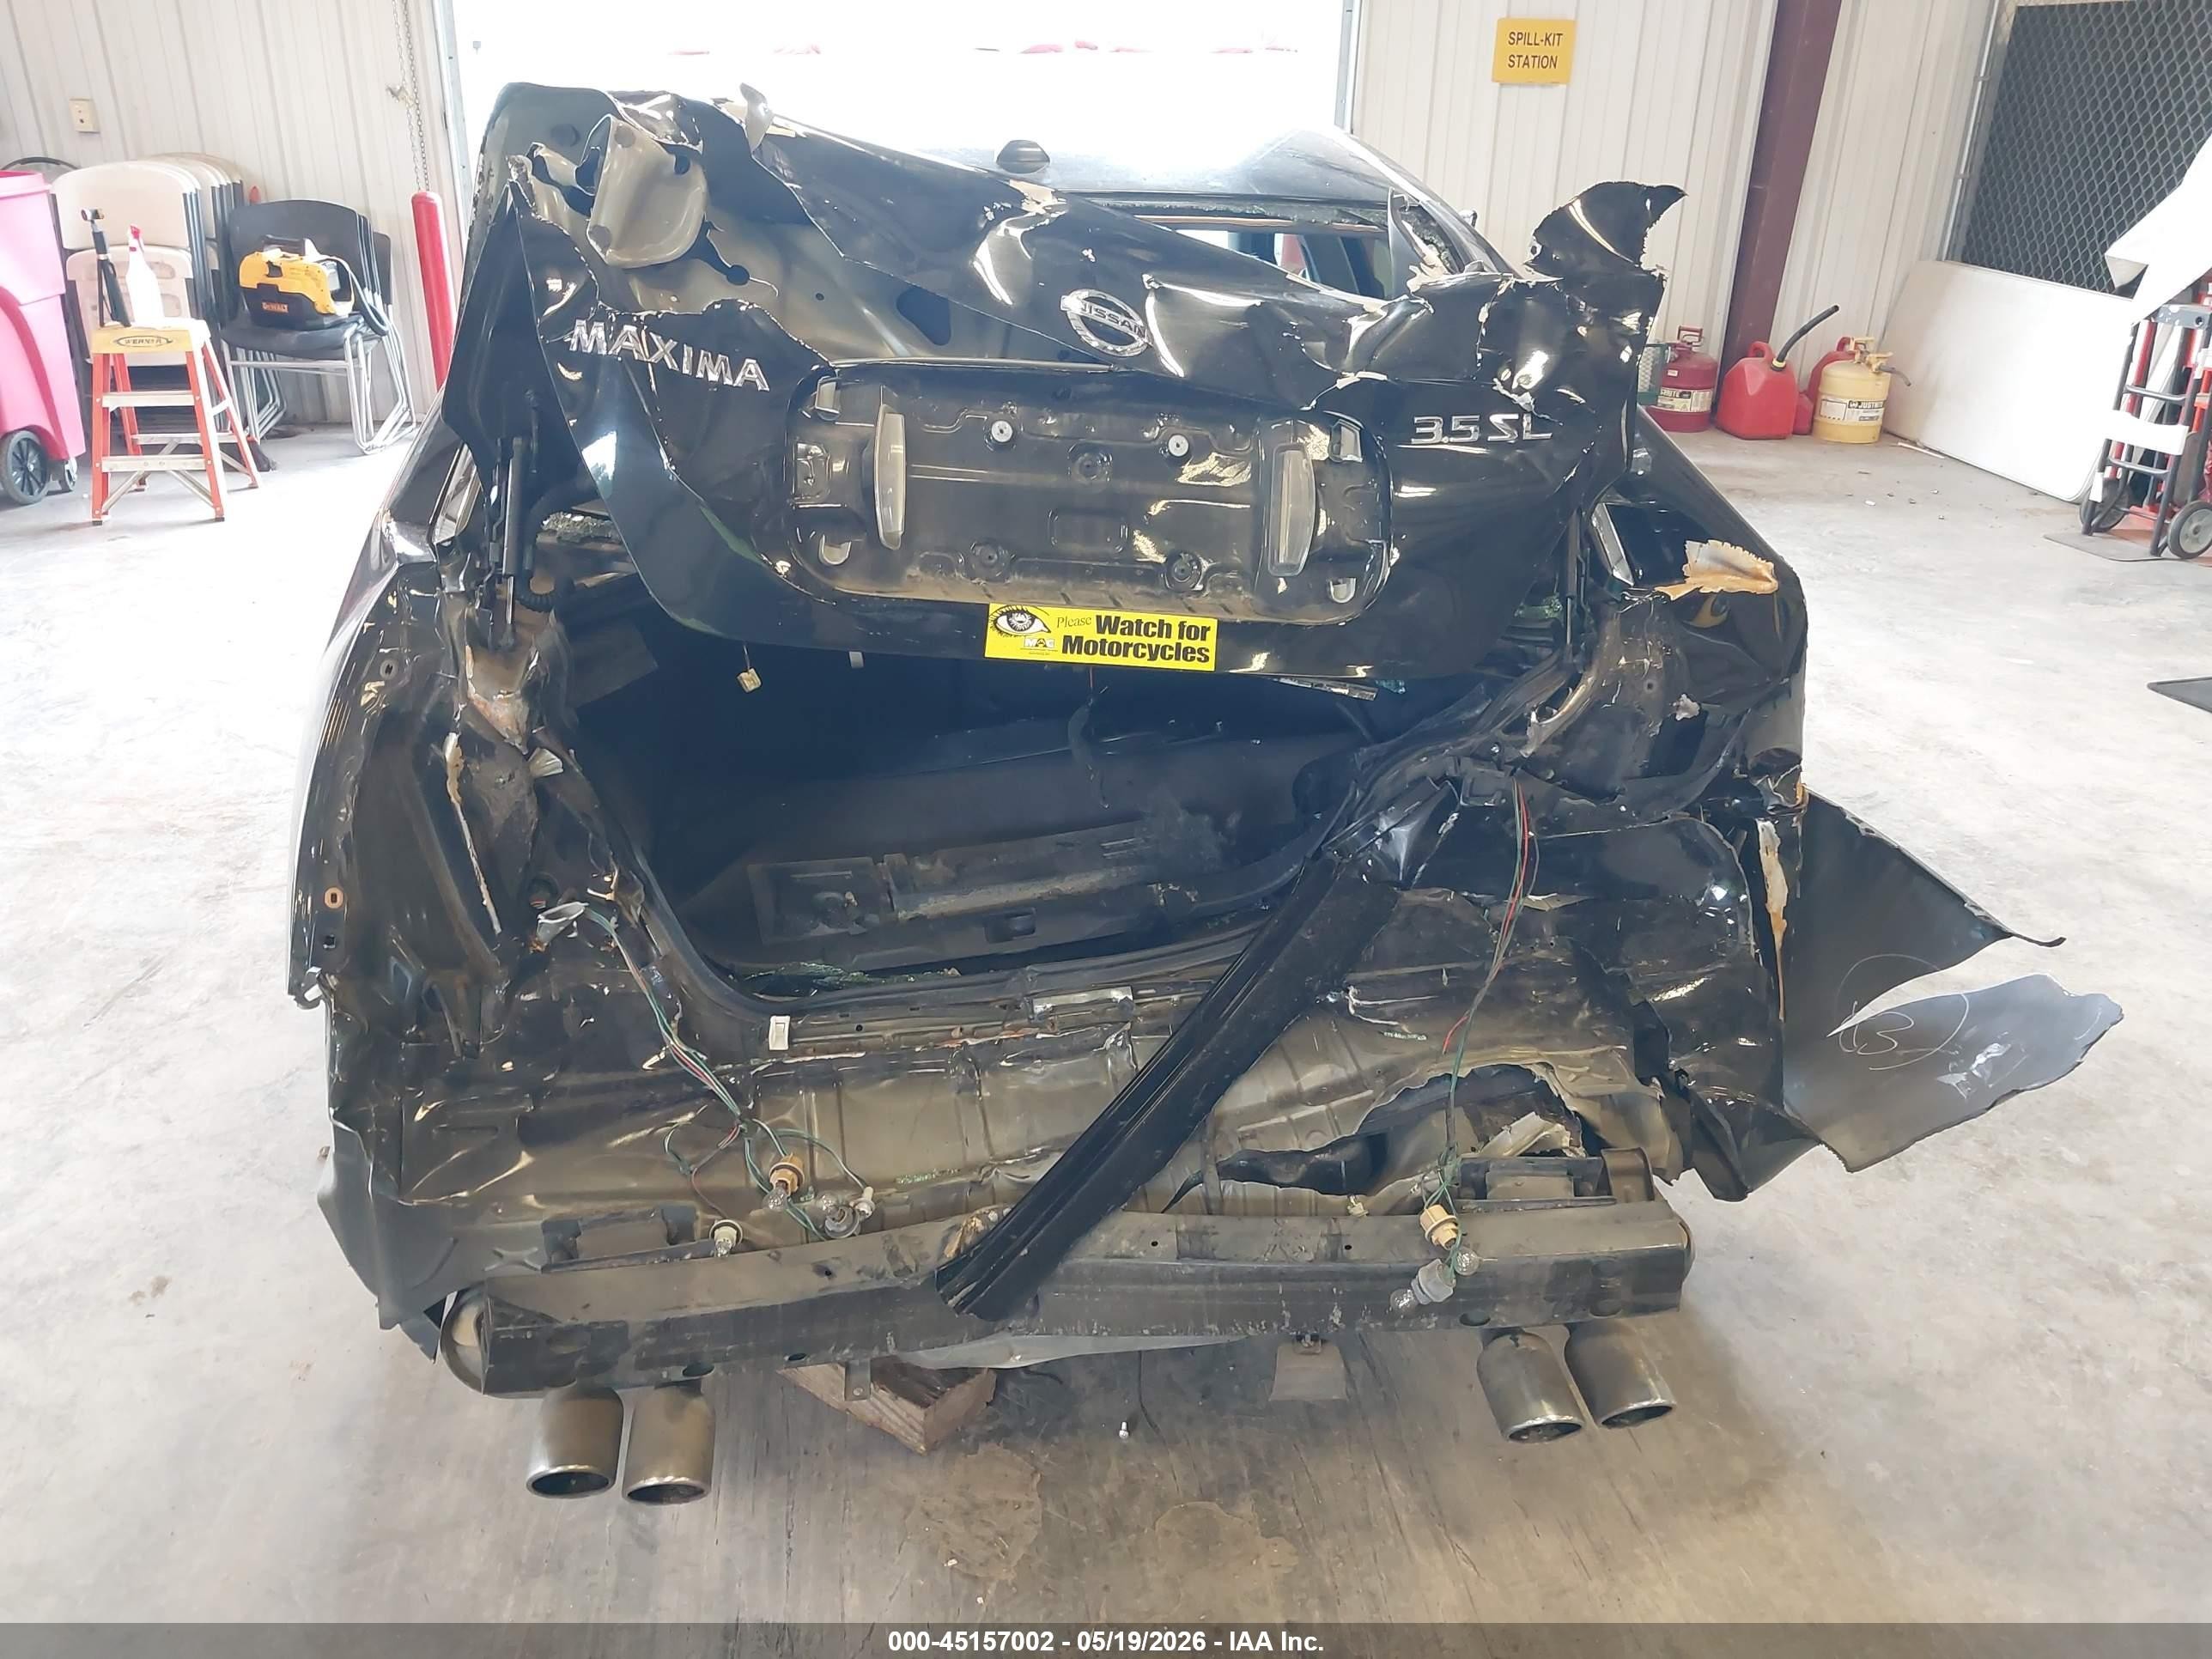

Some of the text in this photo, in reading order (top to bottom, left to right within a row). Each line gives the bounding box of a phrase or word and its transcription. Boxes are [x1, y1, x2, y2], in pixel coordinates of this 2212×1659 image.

[1508, 31, 1564, 46] SPILL-KIT
[1508, 54, 1558, 69] STATION
[569, 319, 769, 392] MAXIMA
[1411, 414, 1553, 444] 3.5 SL
[1057, 615, 1211, 641] Please Watch for
[1062, 635, 1210, 663] Motorcycles
